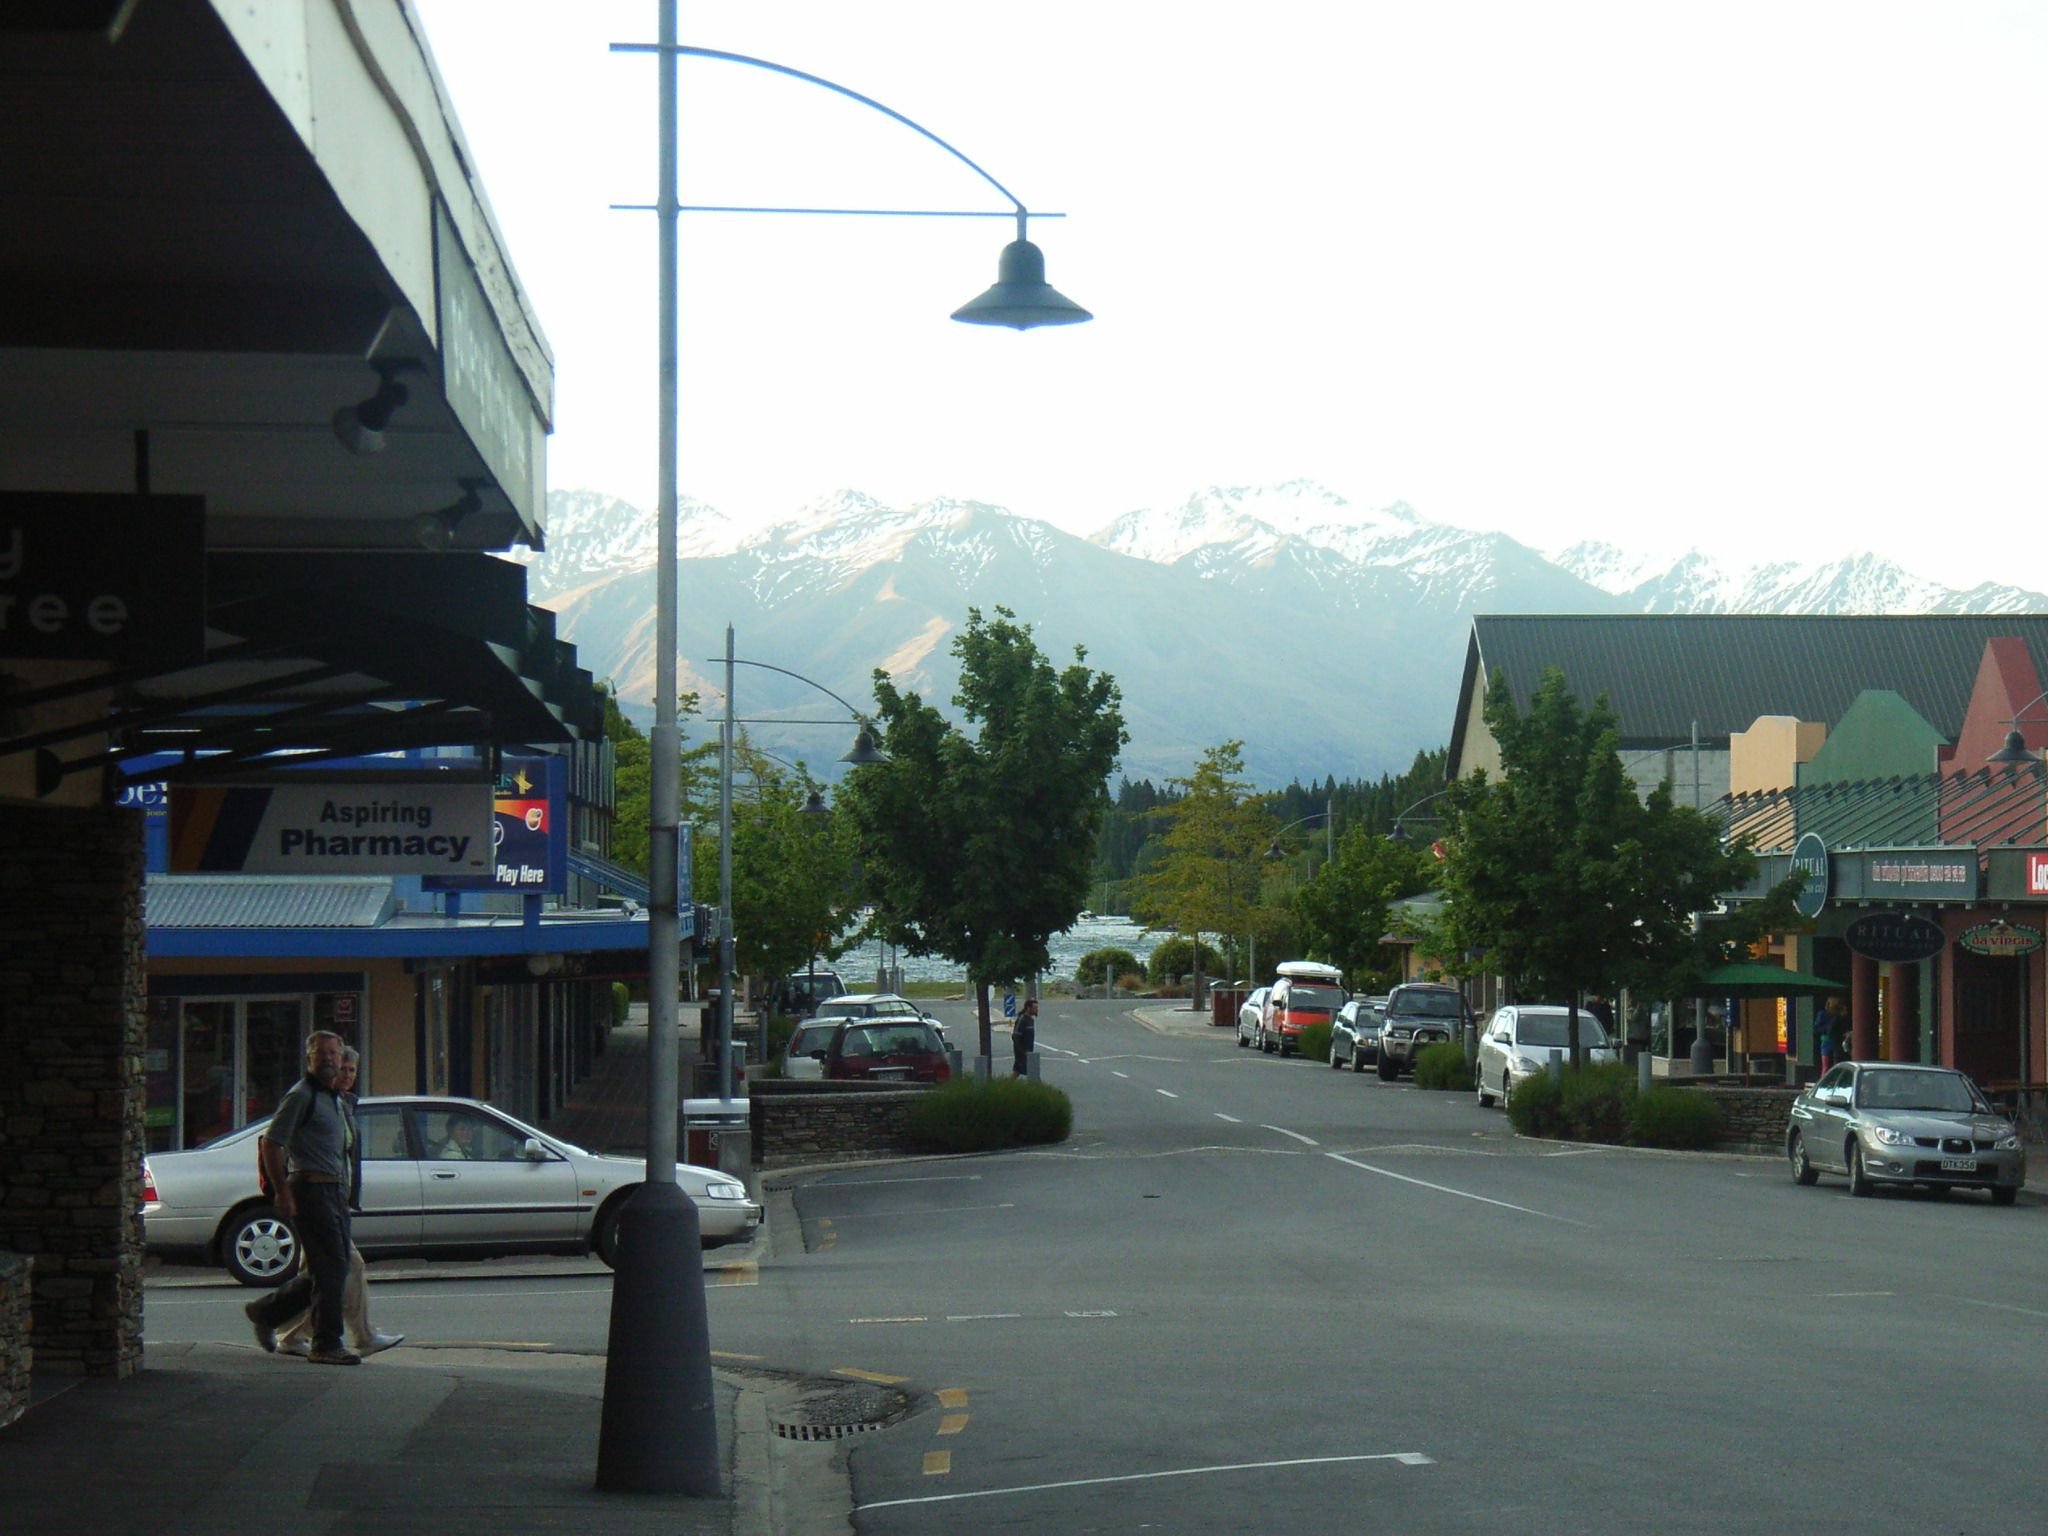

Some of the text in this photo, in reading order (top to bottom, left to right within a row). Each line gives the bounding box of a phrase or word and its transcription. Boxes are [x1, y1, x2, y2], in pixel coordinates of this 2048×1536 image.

[319, 801, 432, 829] Aspiring
[280, 829, 470, 863] Pharmacy
[496, 864, 544, 886] Play Here
[1857, 926, 1935, 940] RITUAL
